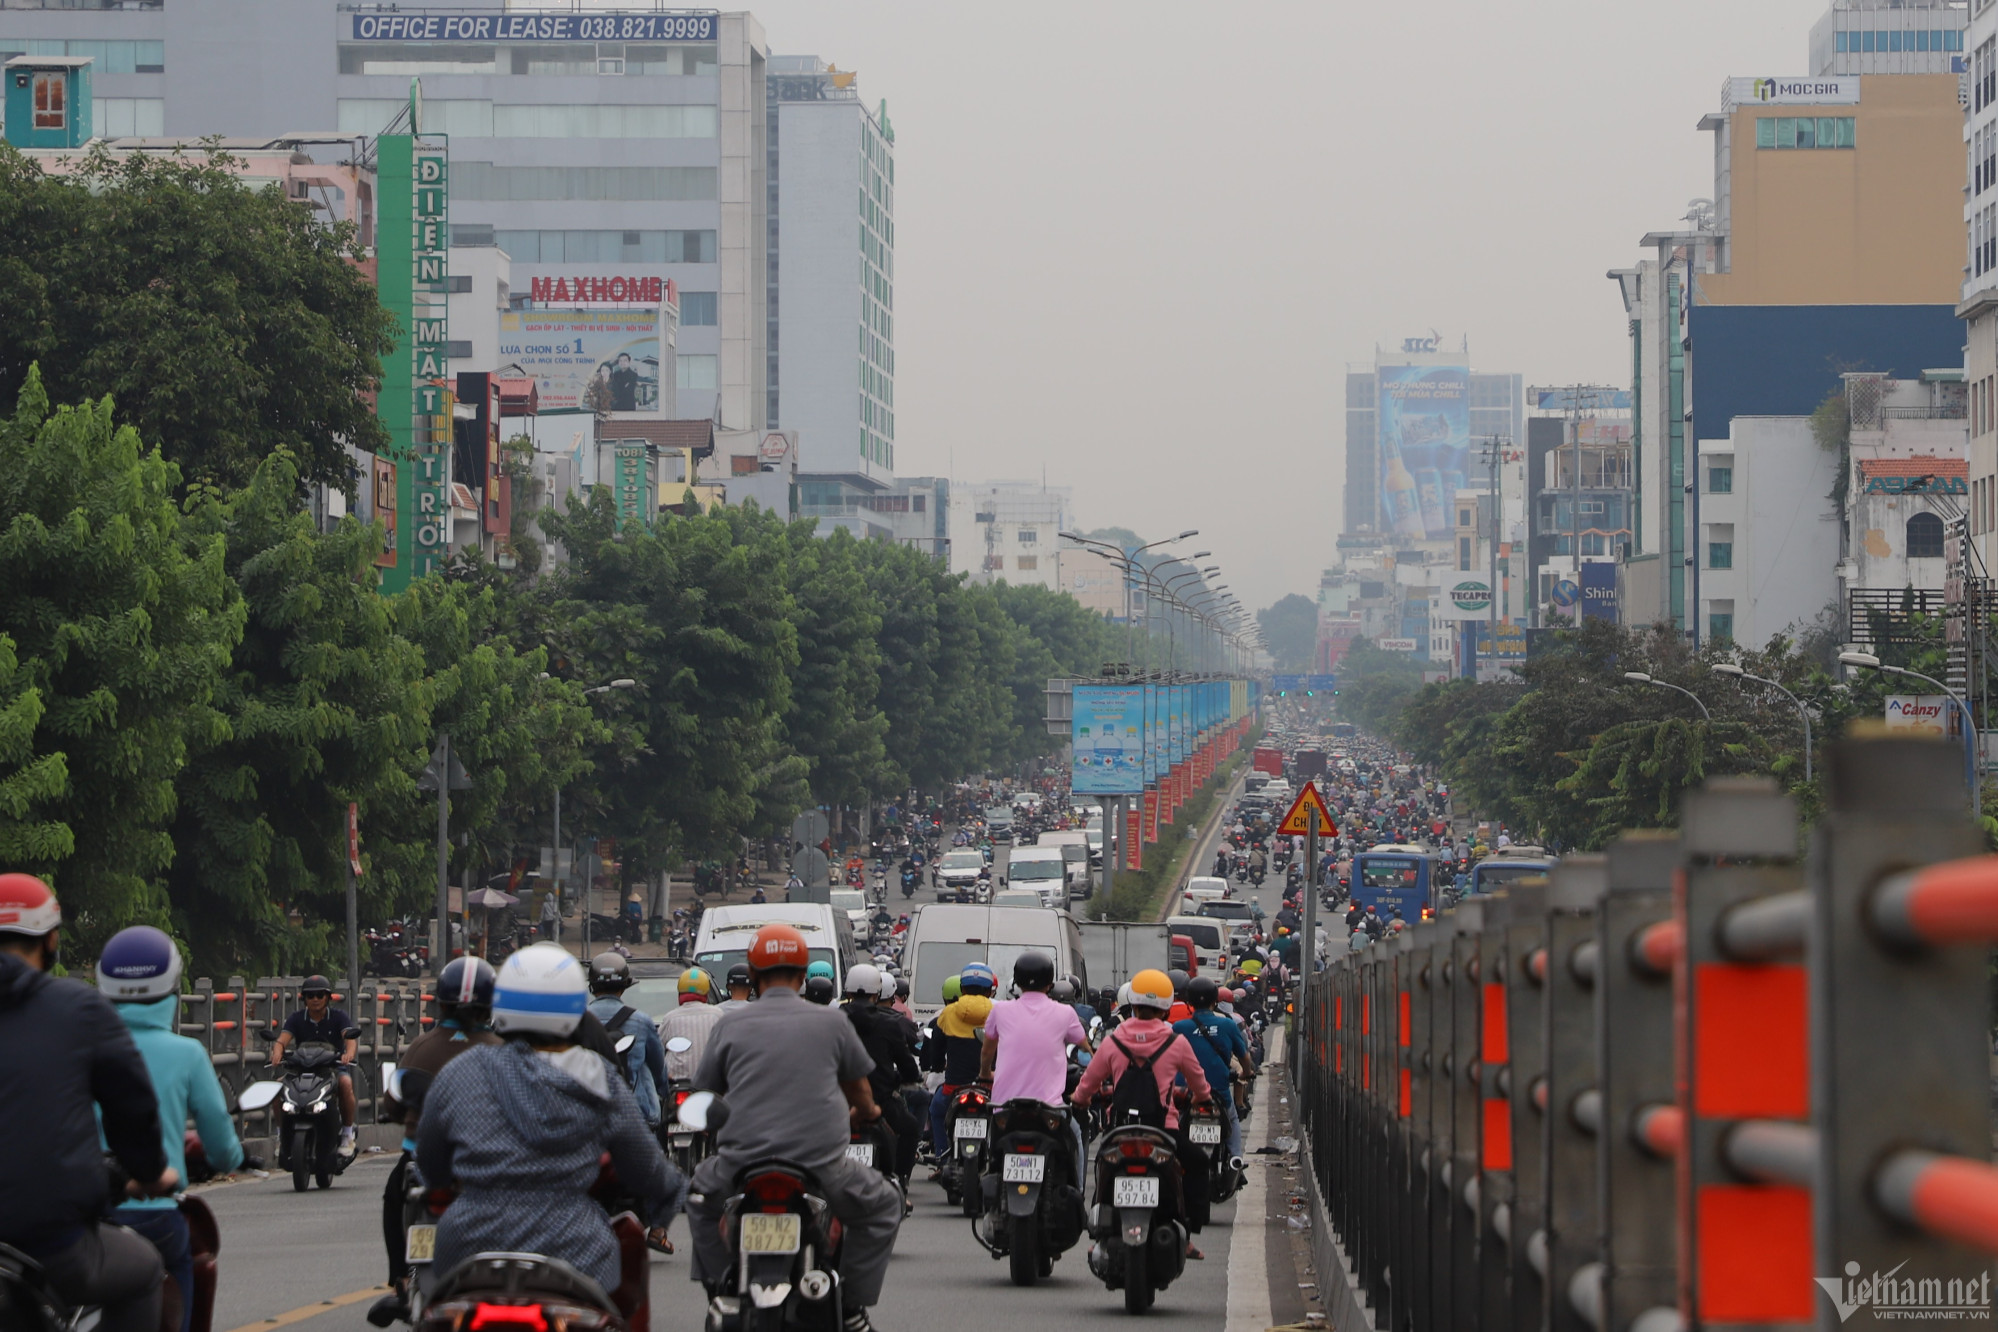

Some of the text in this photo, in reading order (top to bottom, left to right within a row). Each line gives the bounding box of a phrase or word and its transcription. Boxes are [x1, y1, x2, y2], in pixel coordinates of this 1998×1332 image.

[359, 17, 711, 39] OFFICE FOR LEASE: 038.821.9999
[531, 276, 663, 302] MAXHOME
[523, 313, 594, 323] SHOWROOM
[597, 313, 657, 323] MAXHOME
[573, 338, 585, 355] 1
[1902, 703, 1942, 718] Canzy
[779, 944, 798, 954] Food
[1006, 1168, 1041, 1181] 731.12
[1121, 1179, 1151, 1192] 95-E1
